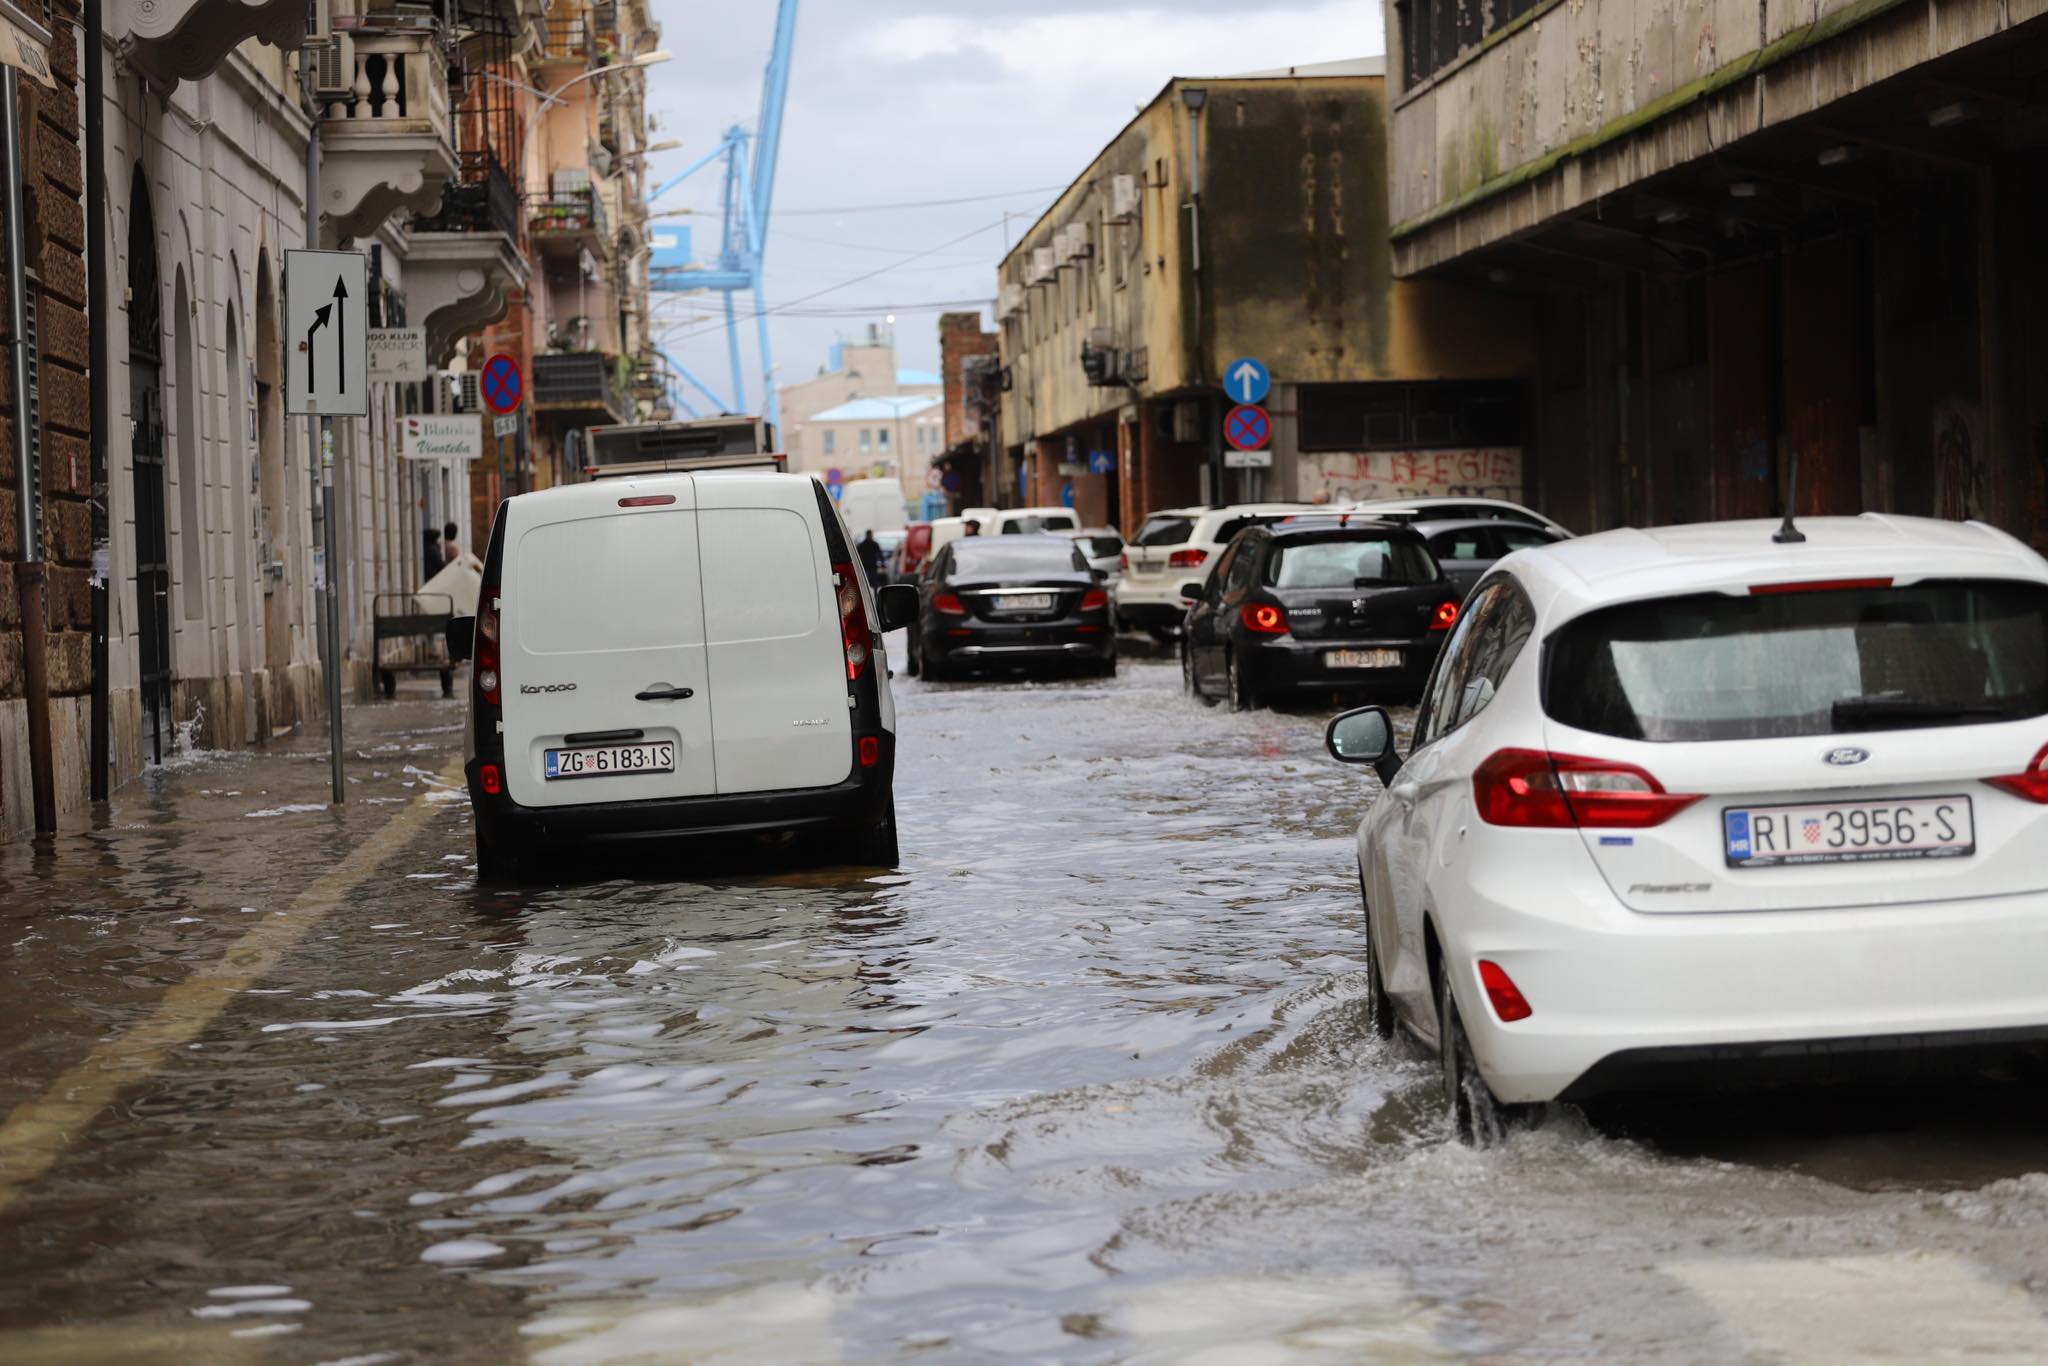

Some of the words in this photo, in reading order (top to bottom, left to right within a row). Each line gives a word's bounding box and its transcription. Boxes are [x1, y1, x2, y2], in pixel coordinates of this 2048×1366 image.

[367, 333, 386, 341] DO
[390, 333, 418, 341] KLUB
[416, 440, 472, 455] Vinoteka
[560, 752, 584, 773] ZG
[1830, 749, 1861, 764] Ford
[1754, 814, 1792, 852] RI
[1825, 805, 1956, 848] 3956-S
[1730, 839, 1749, 852] HR
